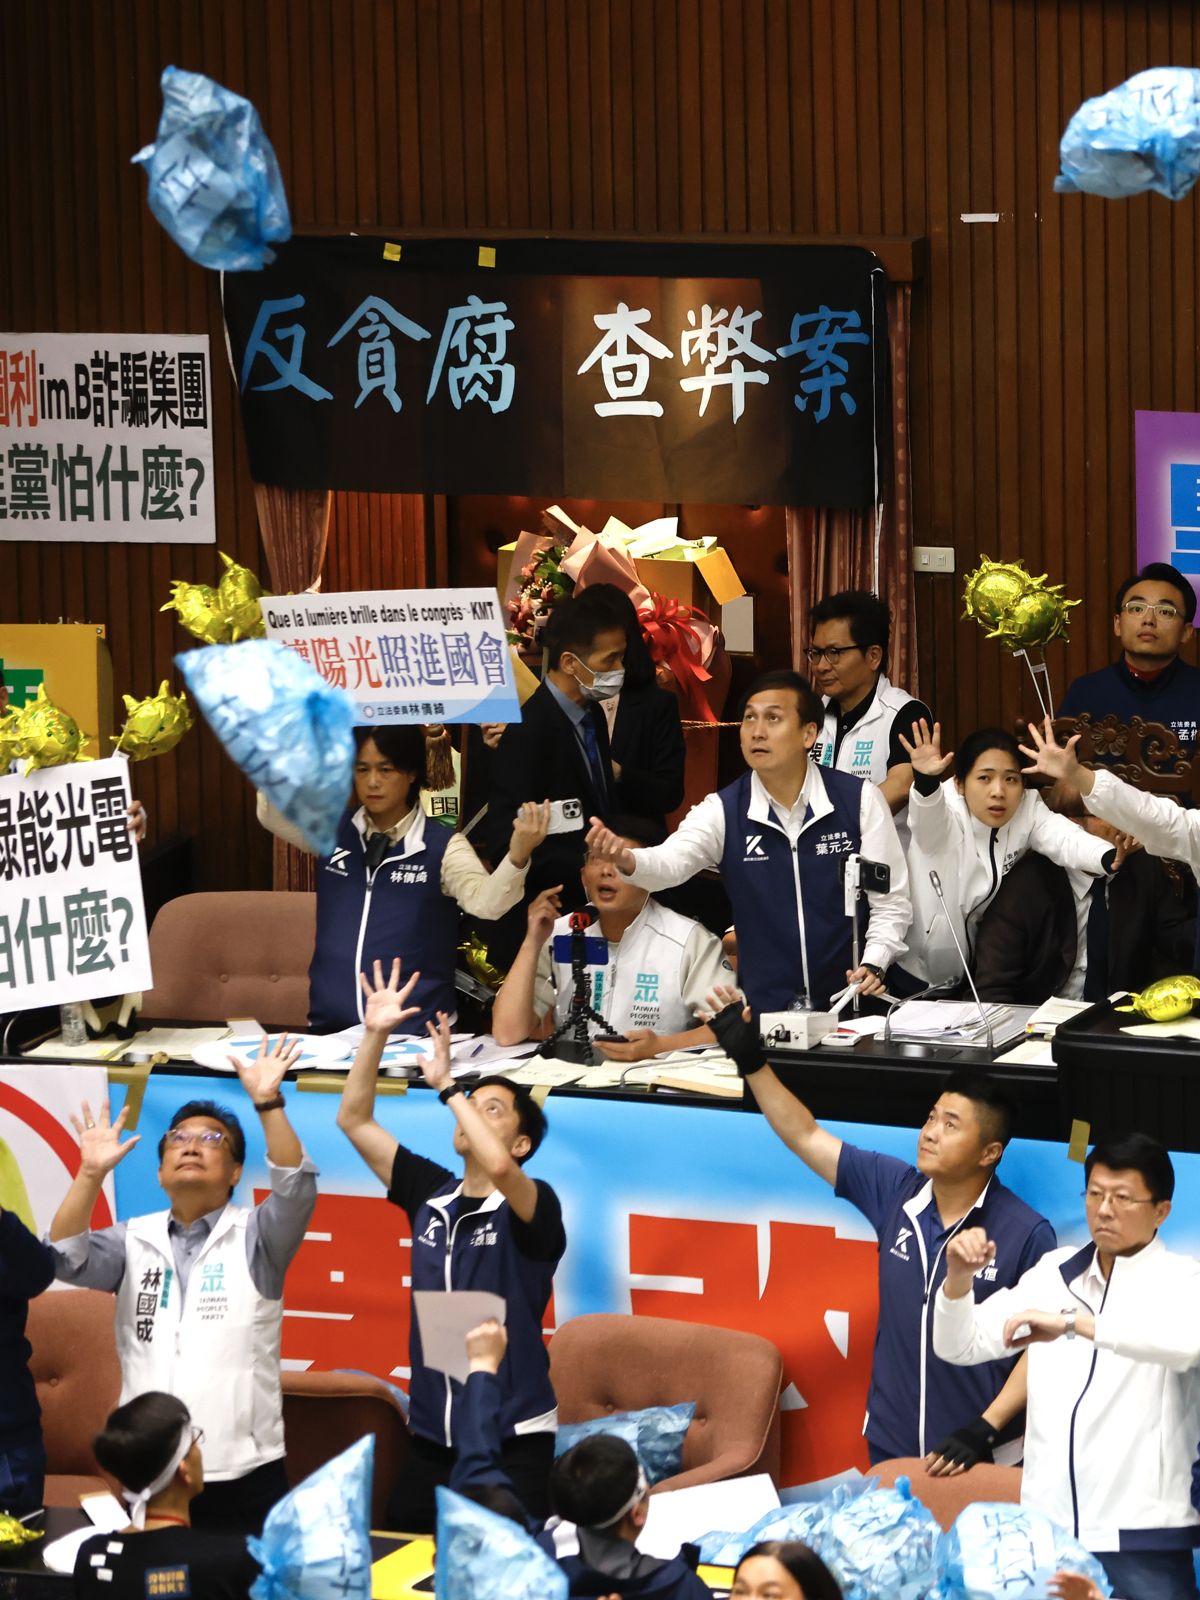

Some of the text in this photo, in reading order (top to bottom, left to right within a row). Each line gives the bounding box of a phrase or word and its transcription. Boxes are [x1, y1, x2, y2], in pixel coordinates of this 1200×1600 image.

[241, 295, 870, 424] 反貪腐 查弊案
[0, 442, 205, 522] 黨怕什麼?
[267, 610, 291, 629] Que
[292, 609, 304, 627] la
[305, 606, 347, 626] lumière
[348, 605, 378, 624] brille
[380, 604, 406, 622] dans
[407, 603, 419, 622] le
[815, 840, 854, 856] 葉元之
[136, 1267, 162, 1343] 林國成
